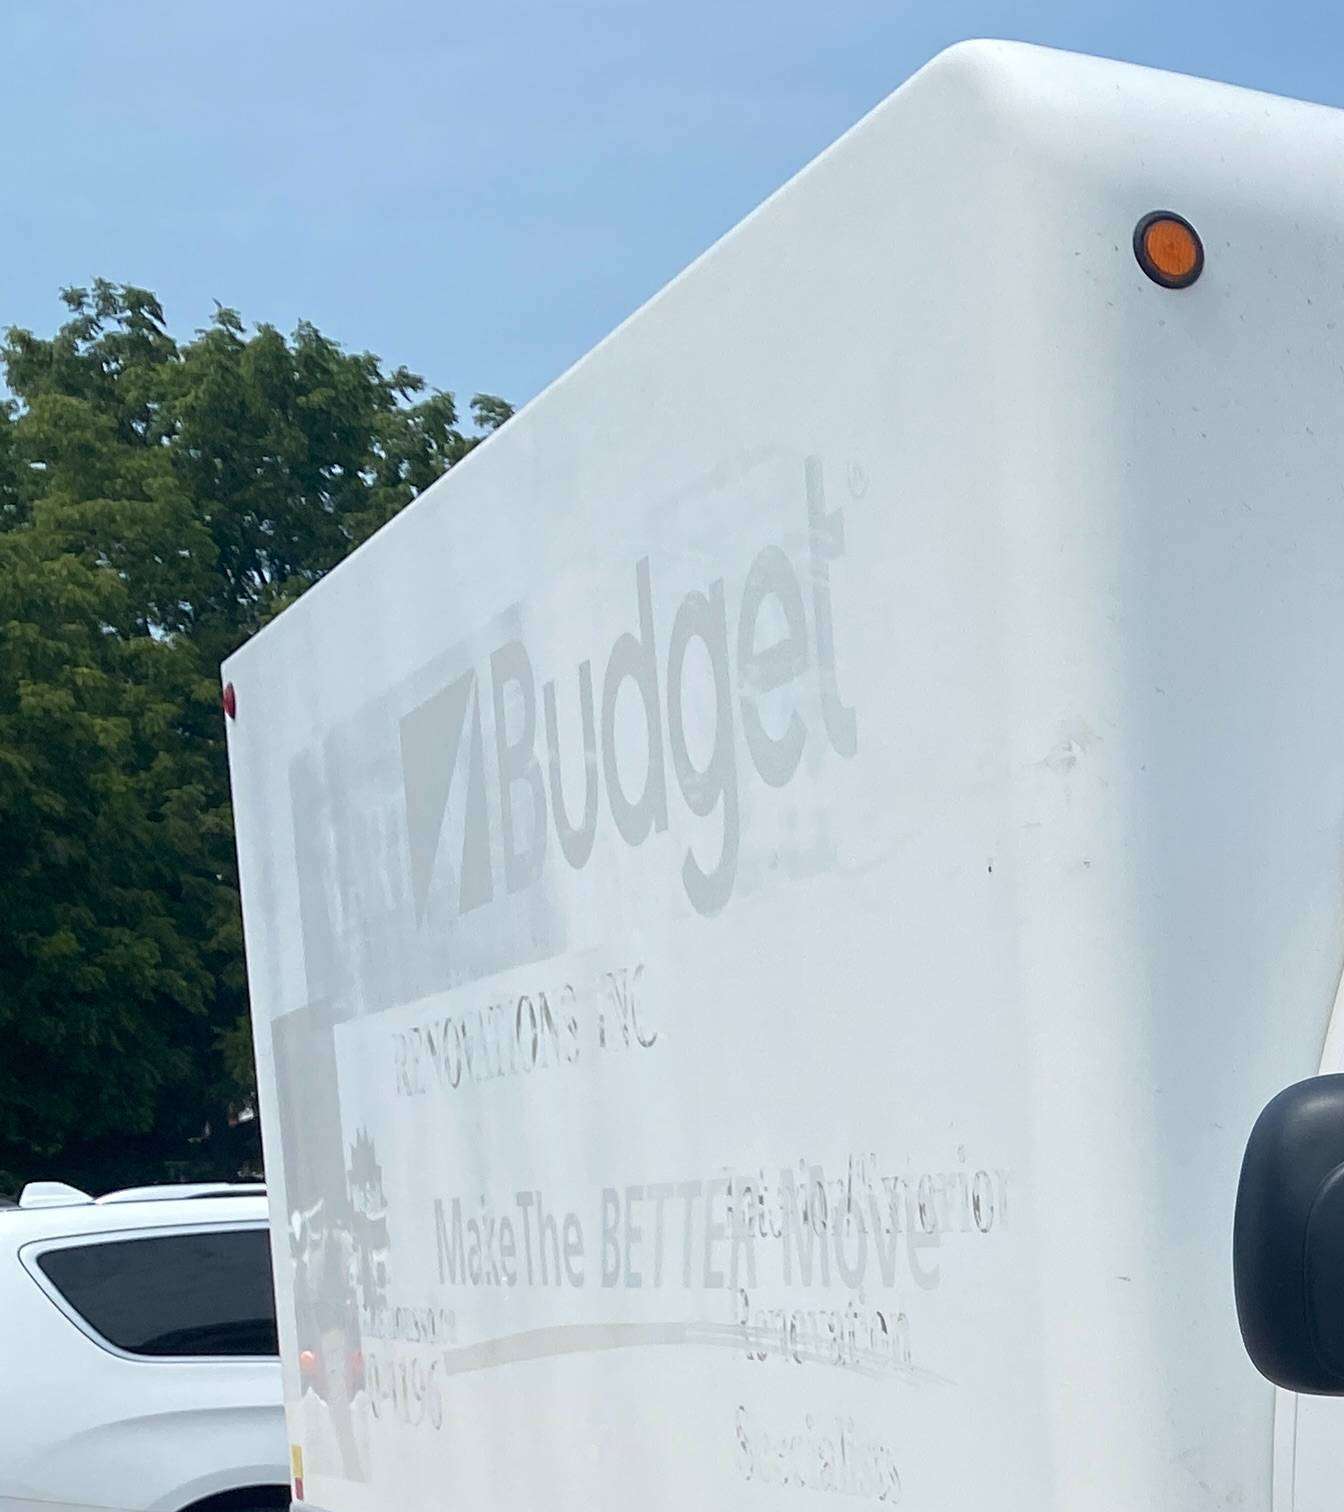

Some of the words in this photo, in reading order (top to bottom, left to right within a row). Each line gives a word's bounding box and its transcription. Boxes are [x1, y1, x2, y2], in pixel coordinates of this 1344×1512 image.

[491, 455, 857, 918] Budget
[600, 1176, 757, 1289] BETTER
[780, 1165, 942, 1291] Move
